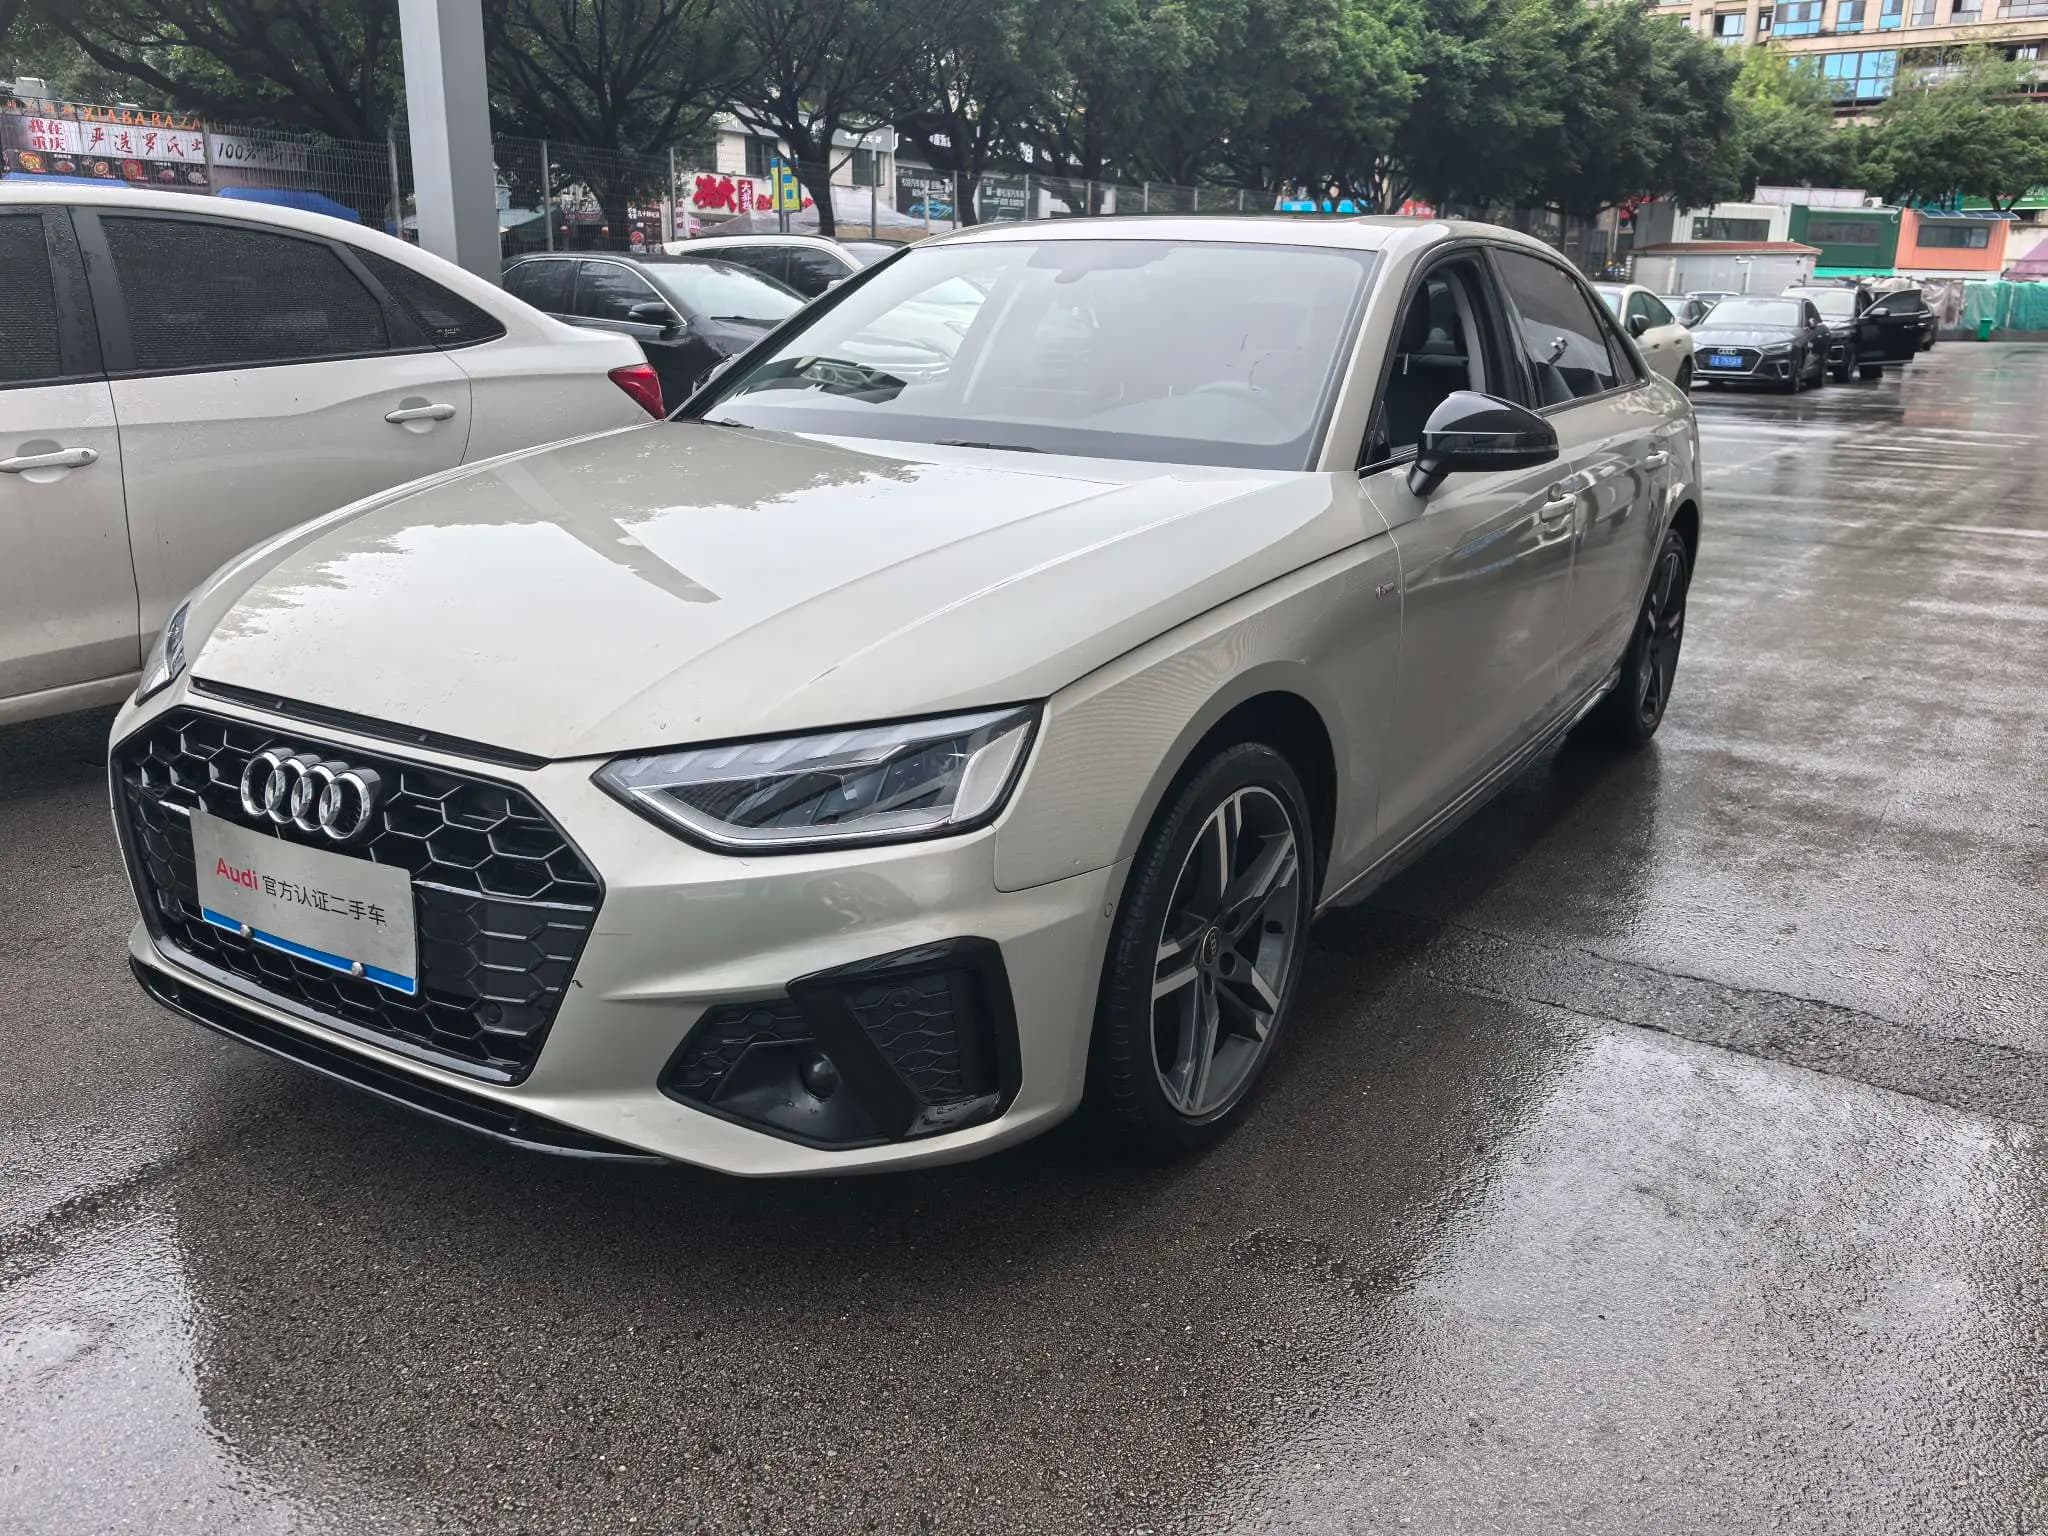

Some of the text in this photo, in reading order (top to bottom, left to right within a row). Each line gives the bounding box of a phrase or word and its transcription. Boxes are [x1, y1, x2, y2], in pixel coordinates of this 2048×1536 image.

[218, 142, 257, 161] 100%
[216, 857, 259, 891] Audi
[262, 875, 388, 927] 官方认证二手车
